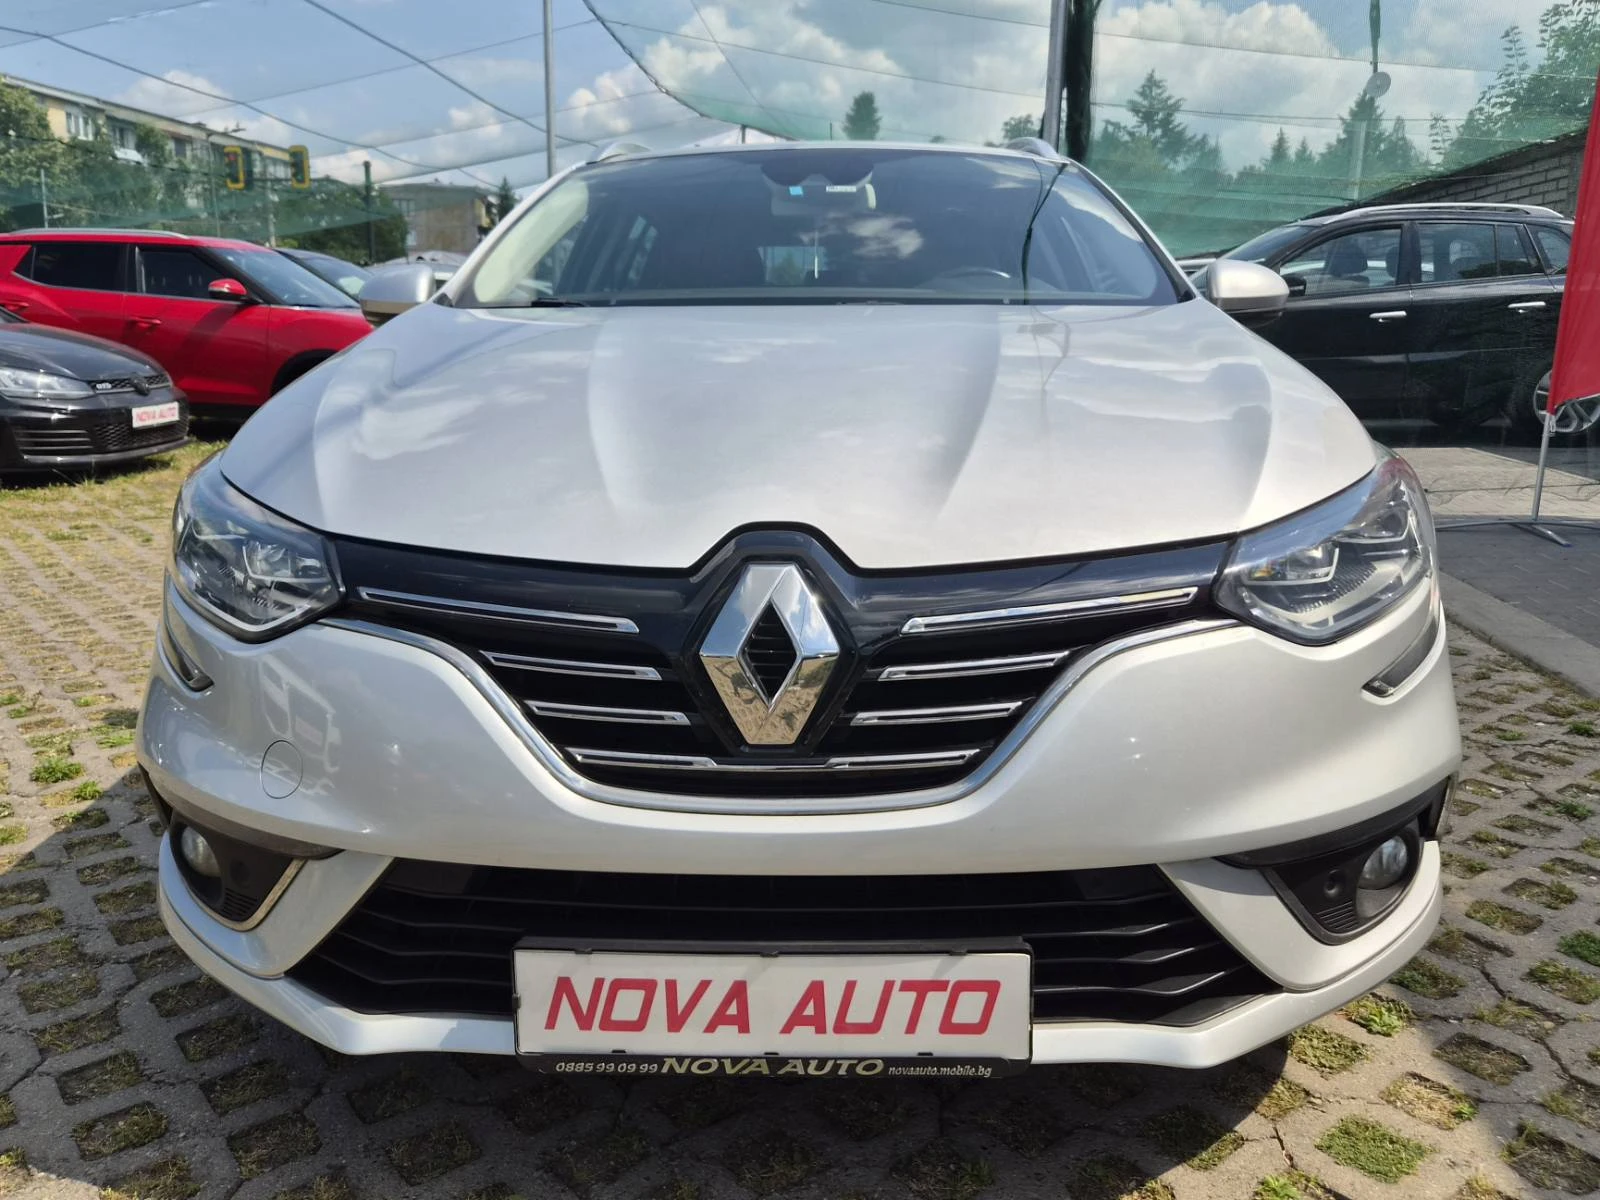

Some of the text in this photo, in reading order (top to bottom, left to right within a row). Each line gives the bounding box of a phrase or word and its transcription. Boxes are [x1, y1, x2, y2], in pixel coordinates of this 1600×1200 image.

[545, 976, 1001, 1035] NOVA AUTO
[555, 1057, 993, 1078] 0885 99 09 99 NOVA AUTO novaauto.mobile.bg
